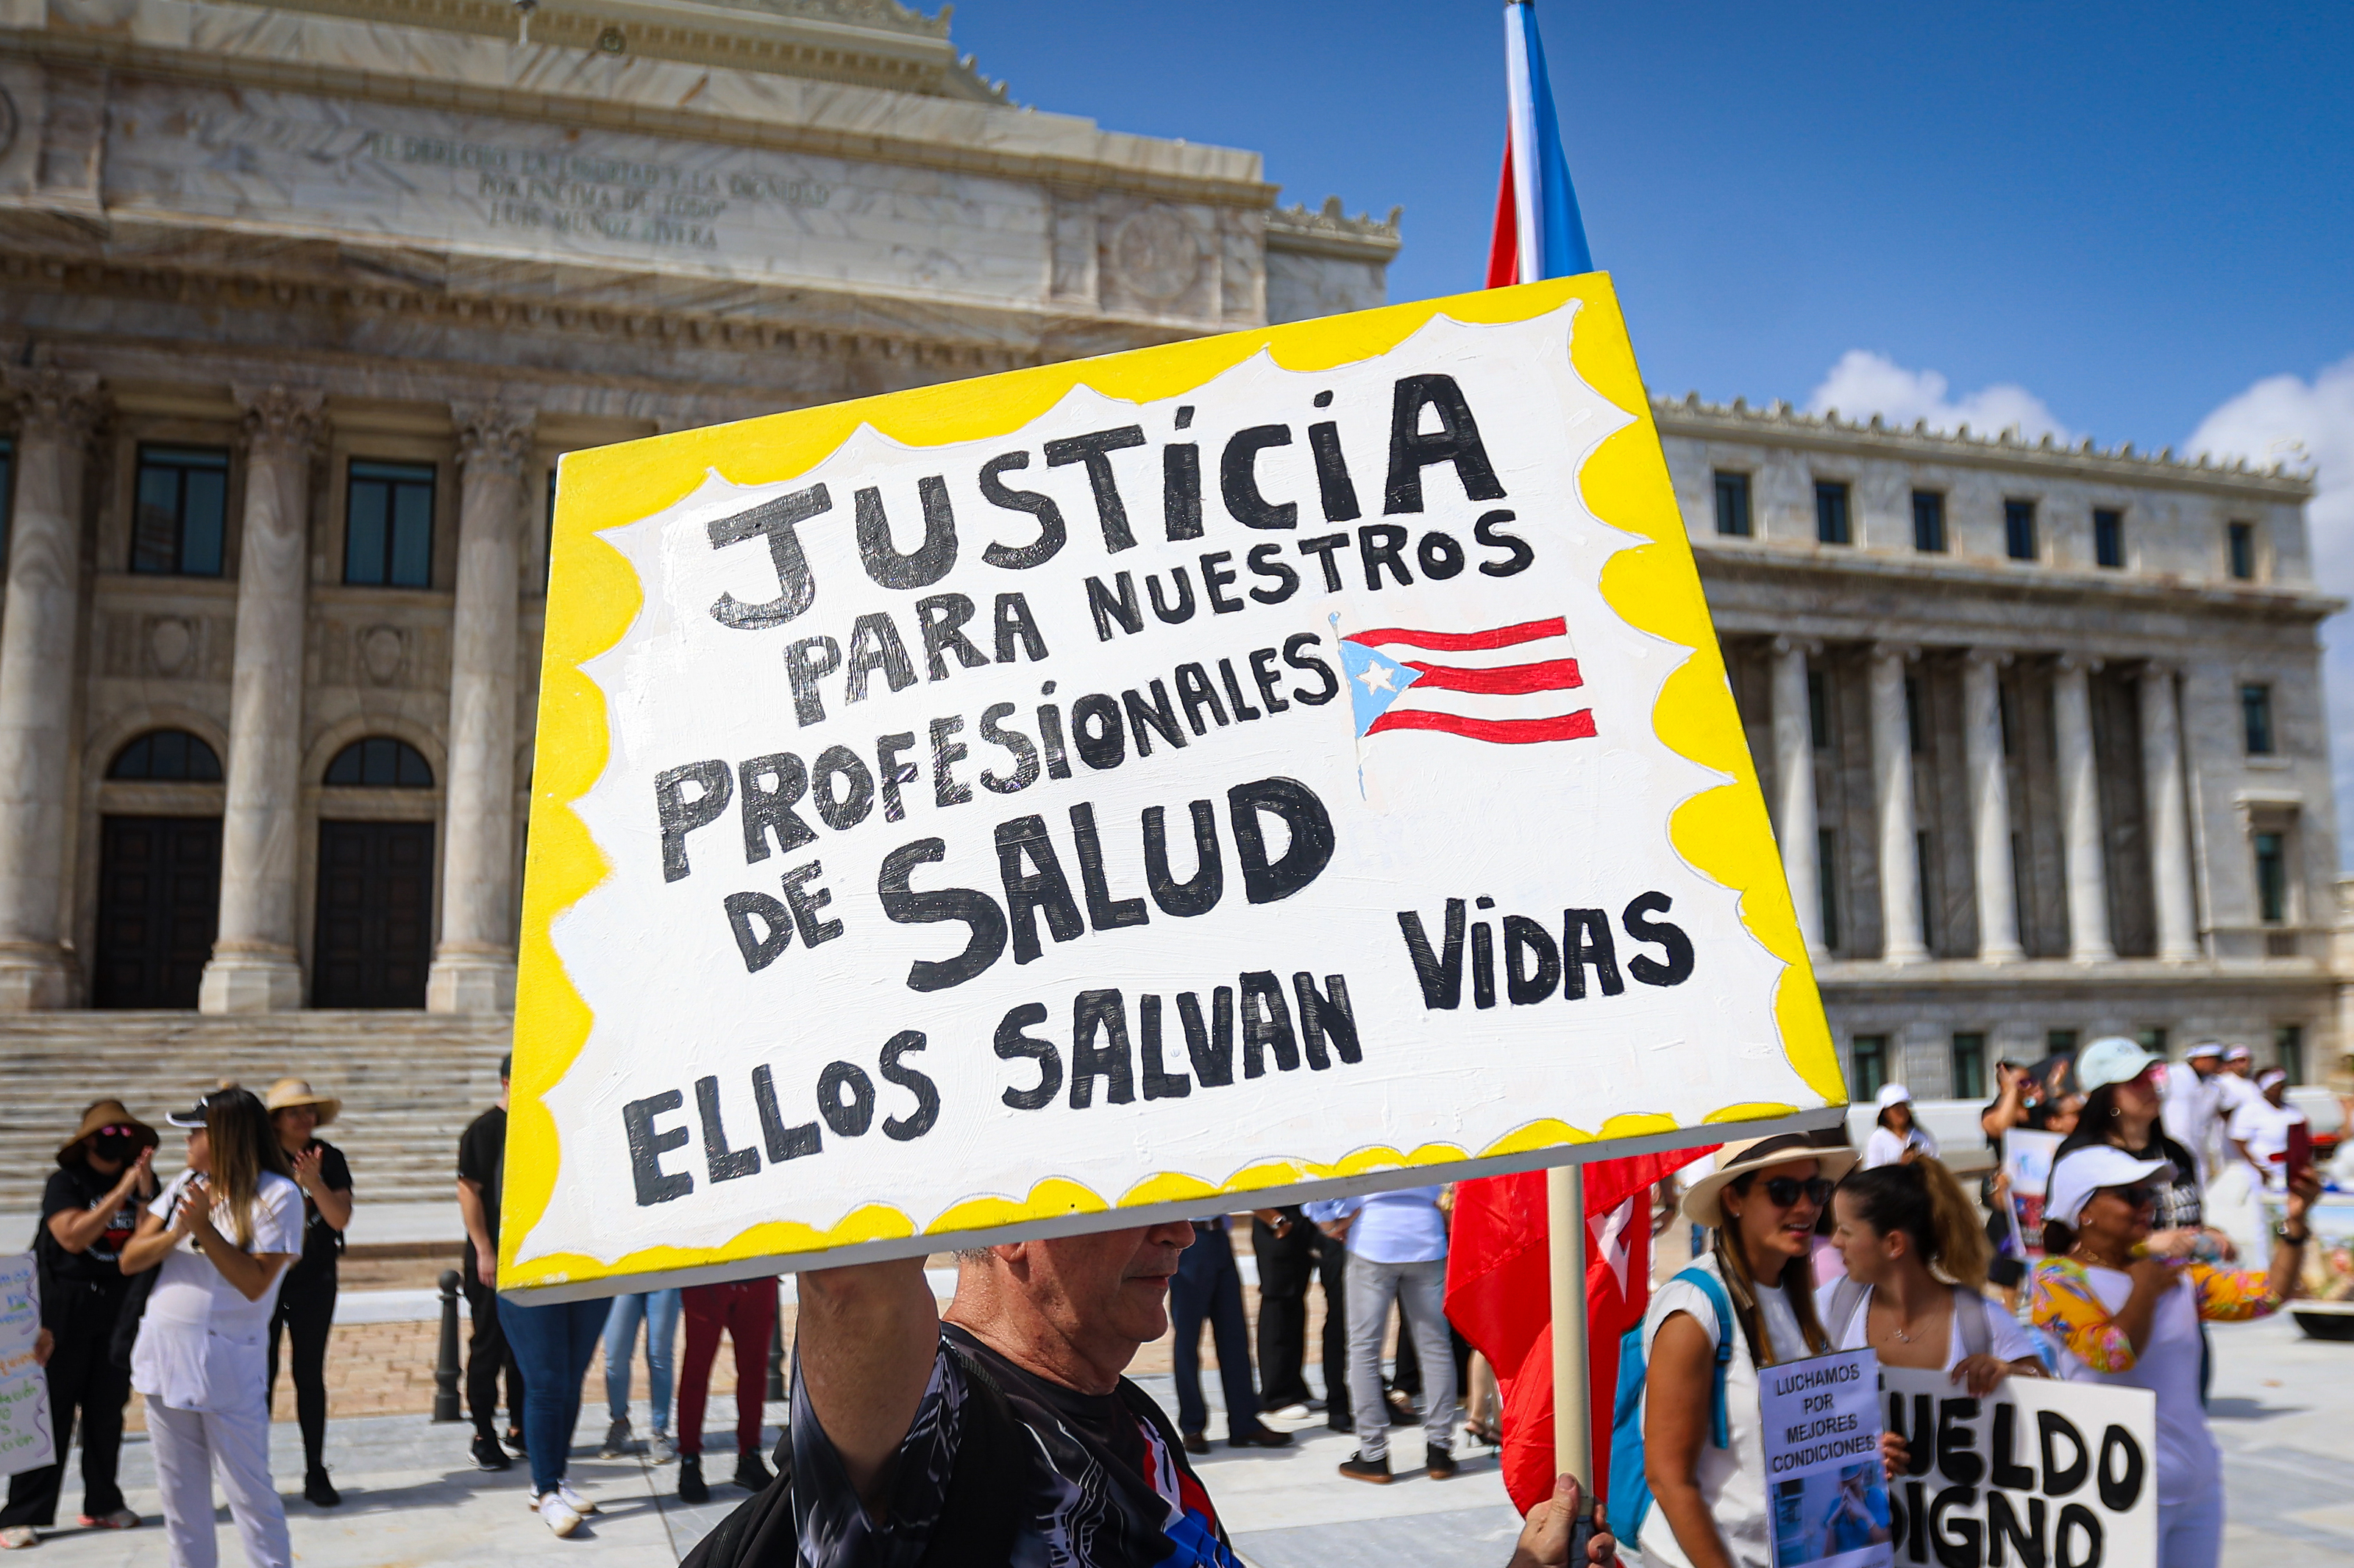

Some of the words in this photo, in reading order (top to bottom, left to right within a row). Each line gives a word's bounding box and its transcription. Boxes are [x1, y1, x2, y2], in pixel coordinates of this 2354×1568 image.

[783, 592, 1049, 727] PARA
[724, 859, 844, 973] DE
[878, 777, 1335, 993] SALUD
[994, 970, 1362, 1111] SALVAN
[1777, 1364, 1860, 1396] LUCHAMOS
[1804, 1393, 1834, 1415] POR
[1773, 1435, 1876, 1472] CONDICIONES
[1787, 1414, 1857, 1444] MEJORES
[1879, 1373, 2143, 1511] UELDO
